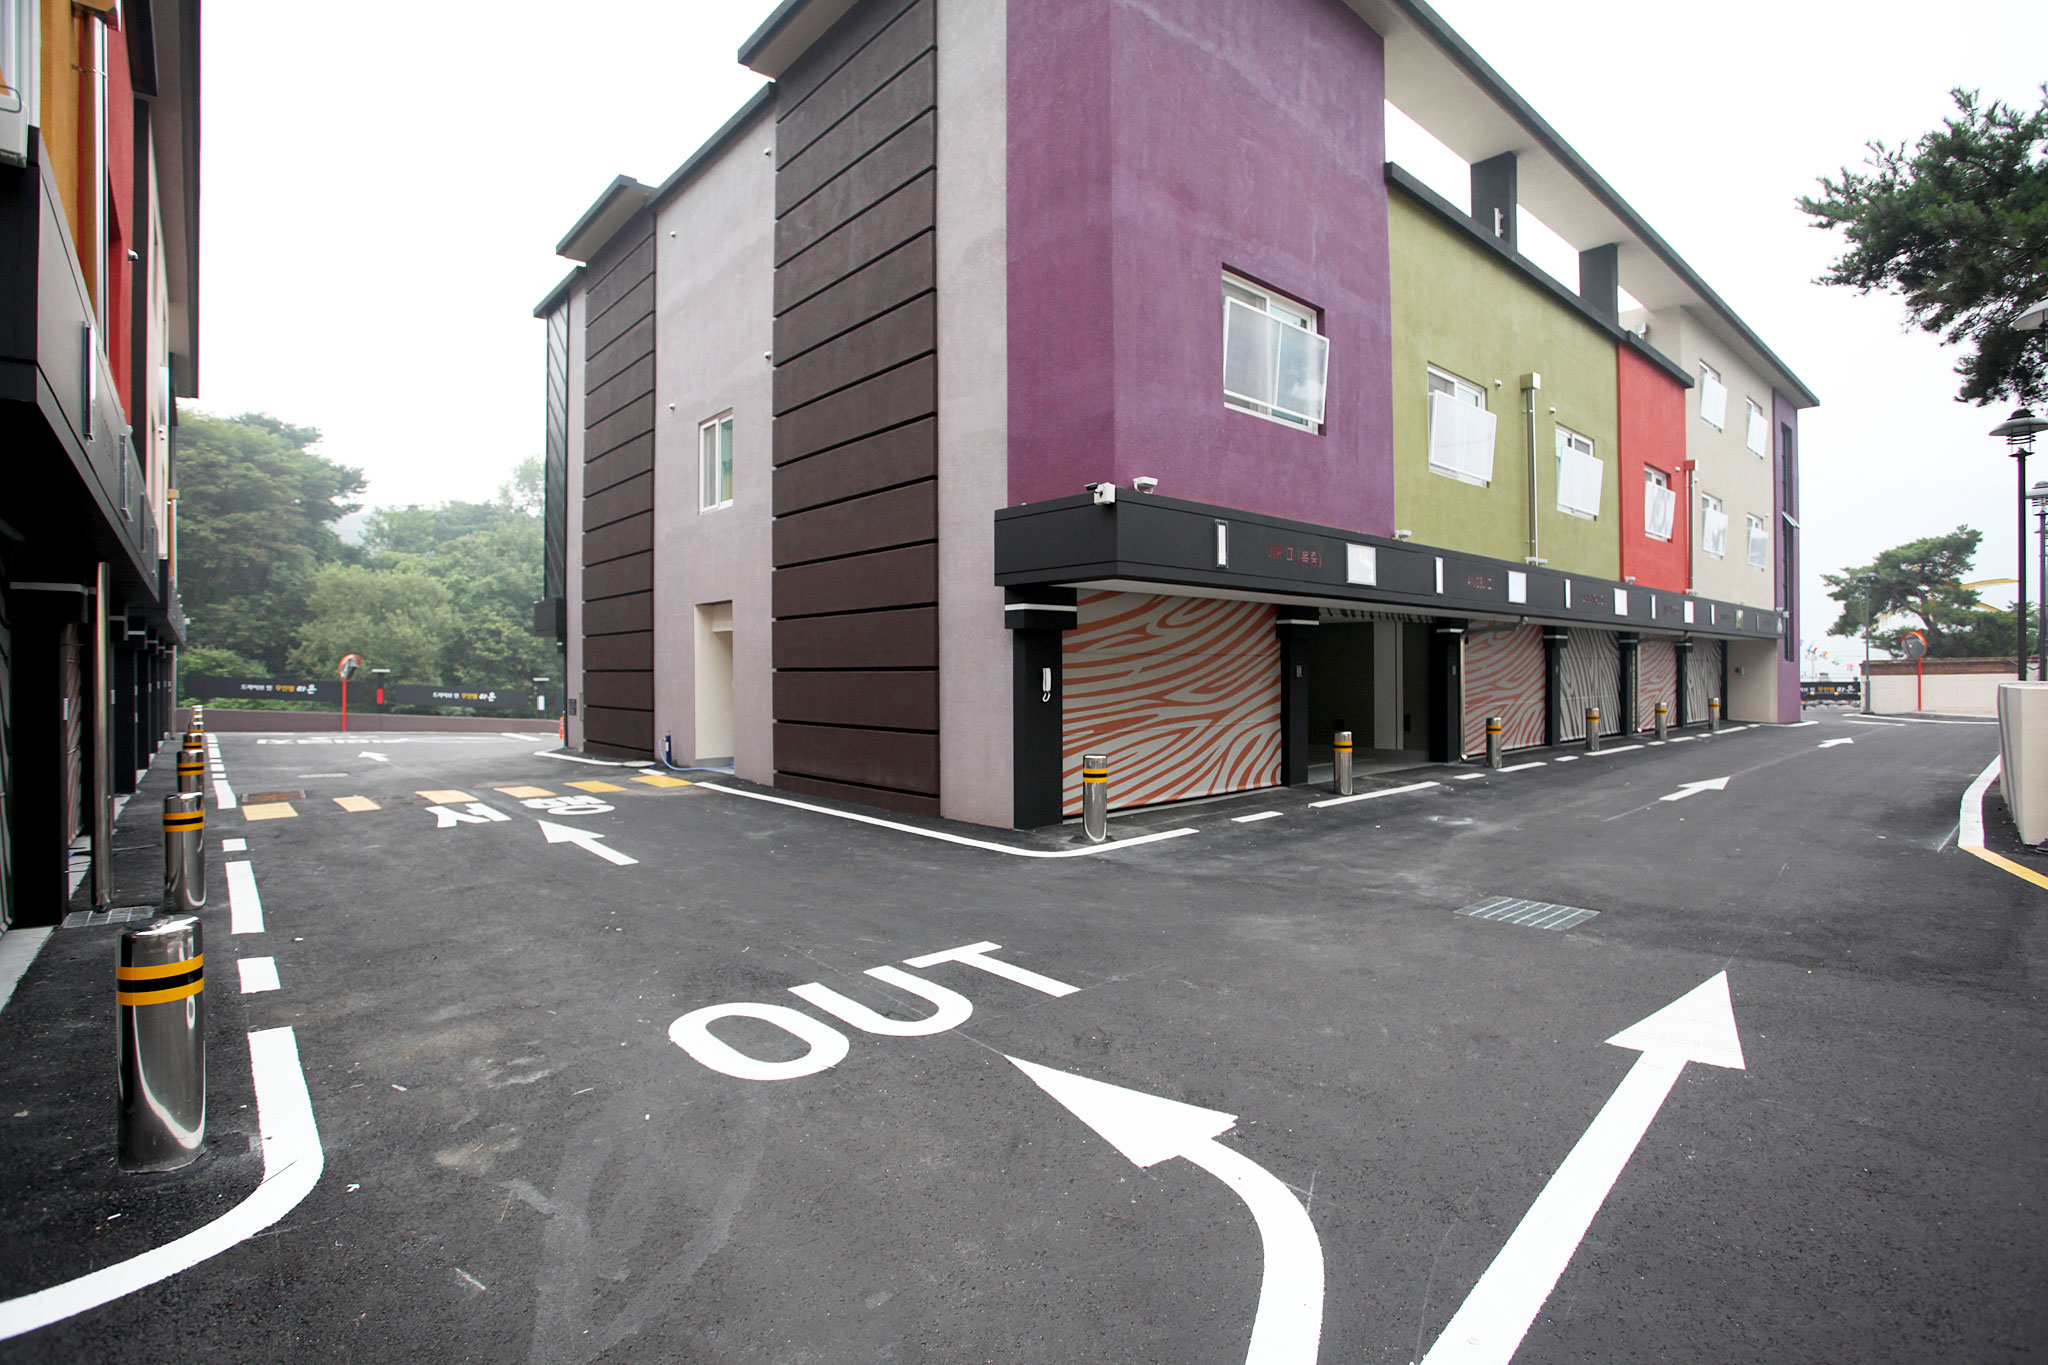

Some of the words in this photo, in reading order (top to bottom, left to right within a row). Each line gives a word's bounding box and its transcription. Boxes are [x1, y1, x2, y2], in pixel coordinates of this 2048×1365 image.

[1266, 544, 1283, 560] VIP
[425, 795, 615, 828] 서행
[668, 941, 1081, 1081] OUT
